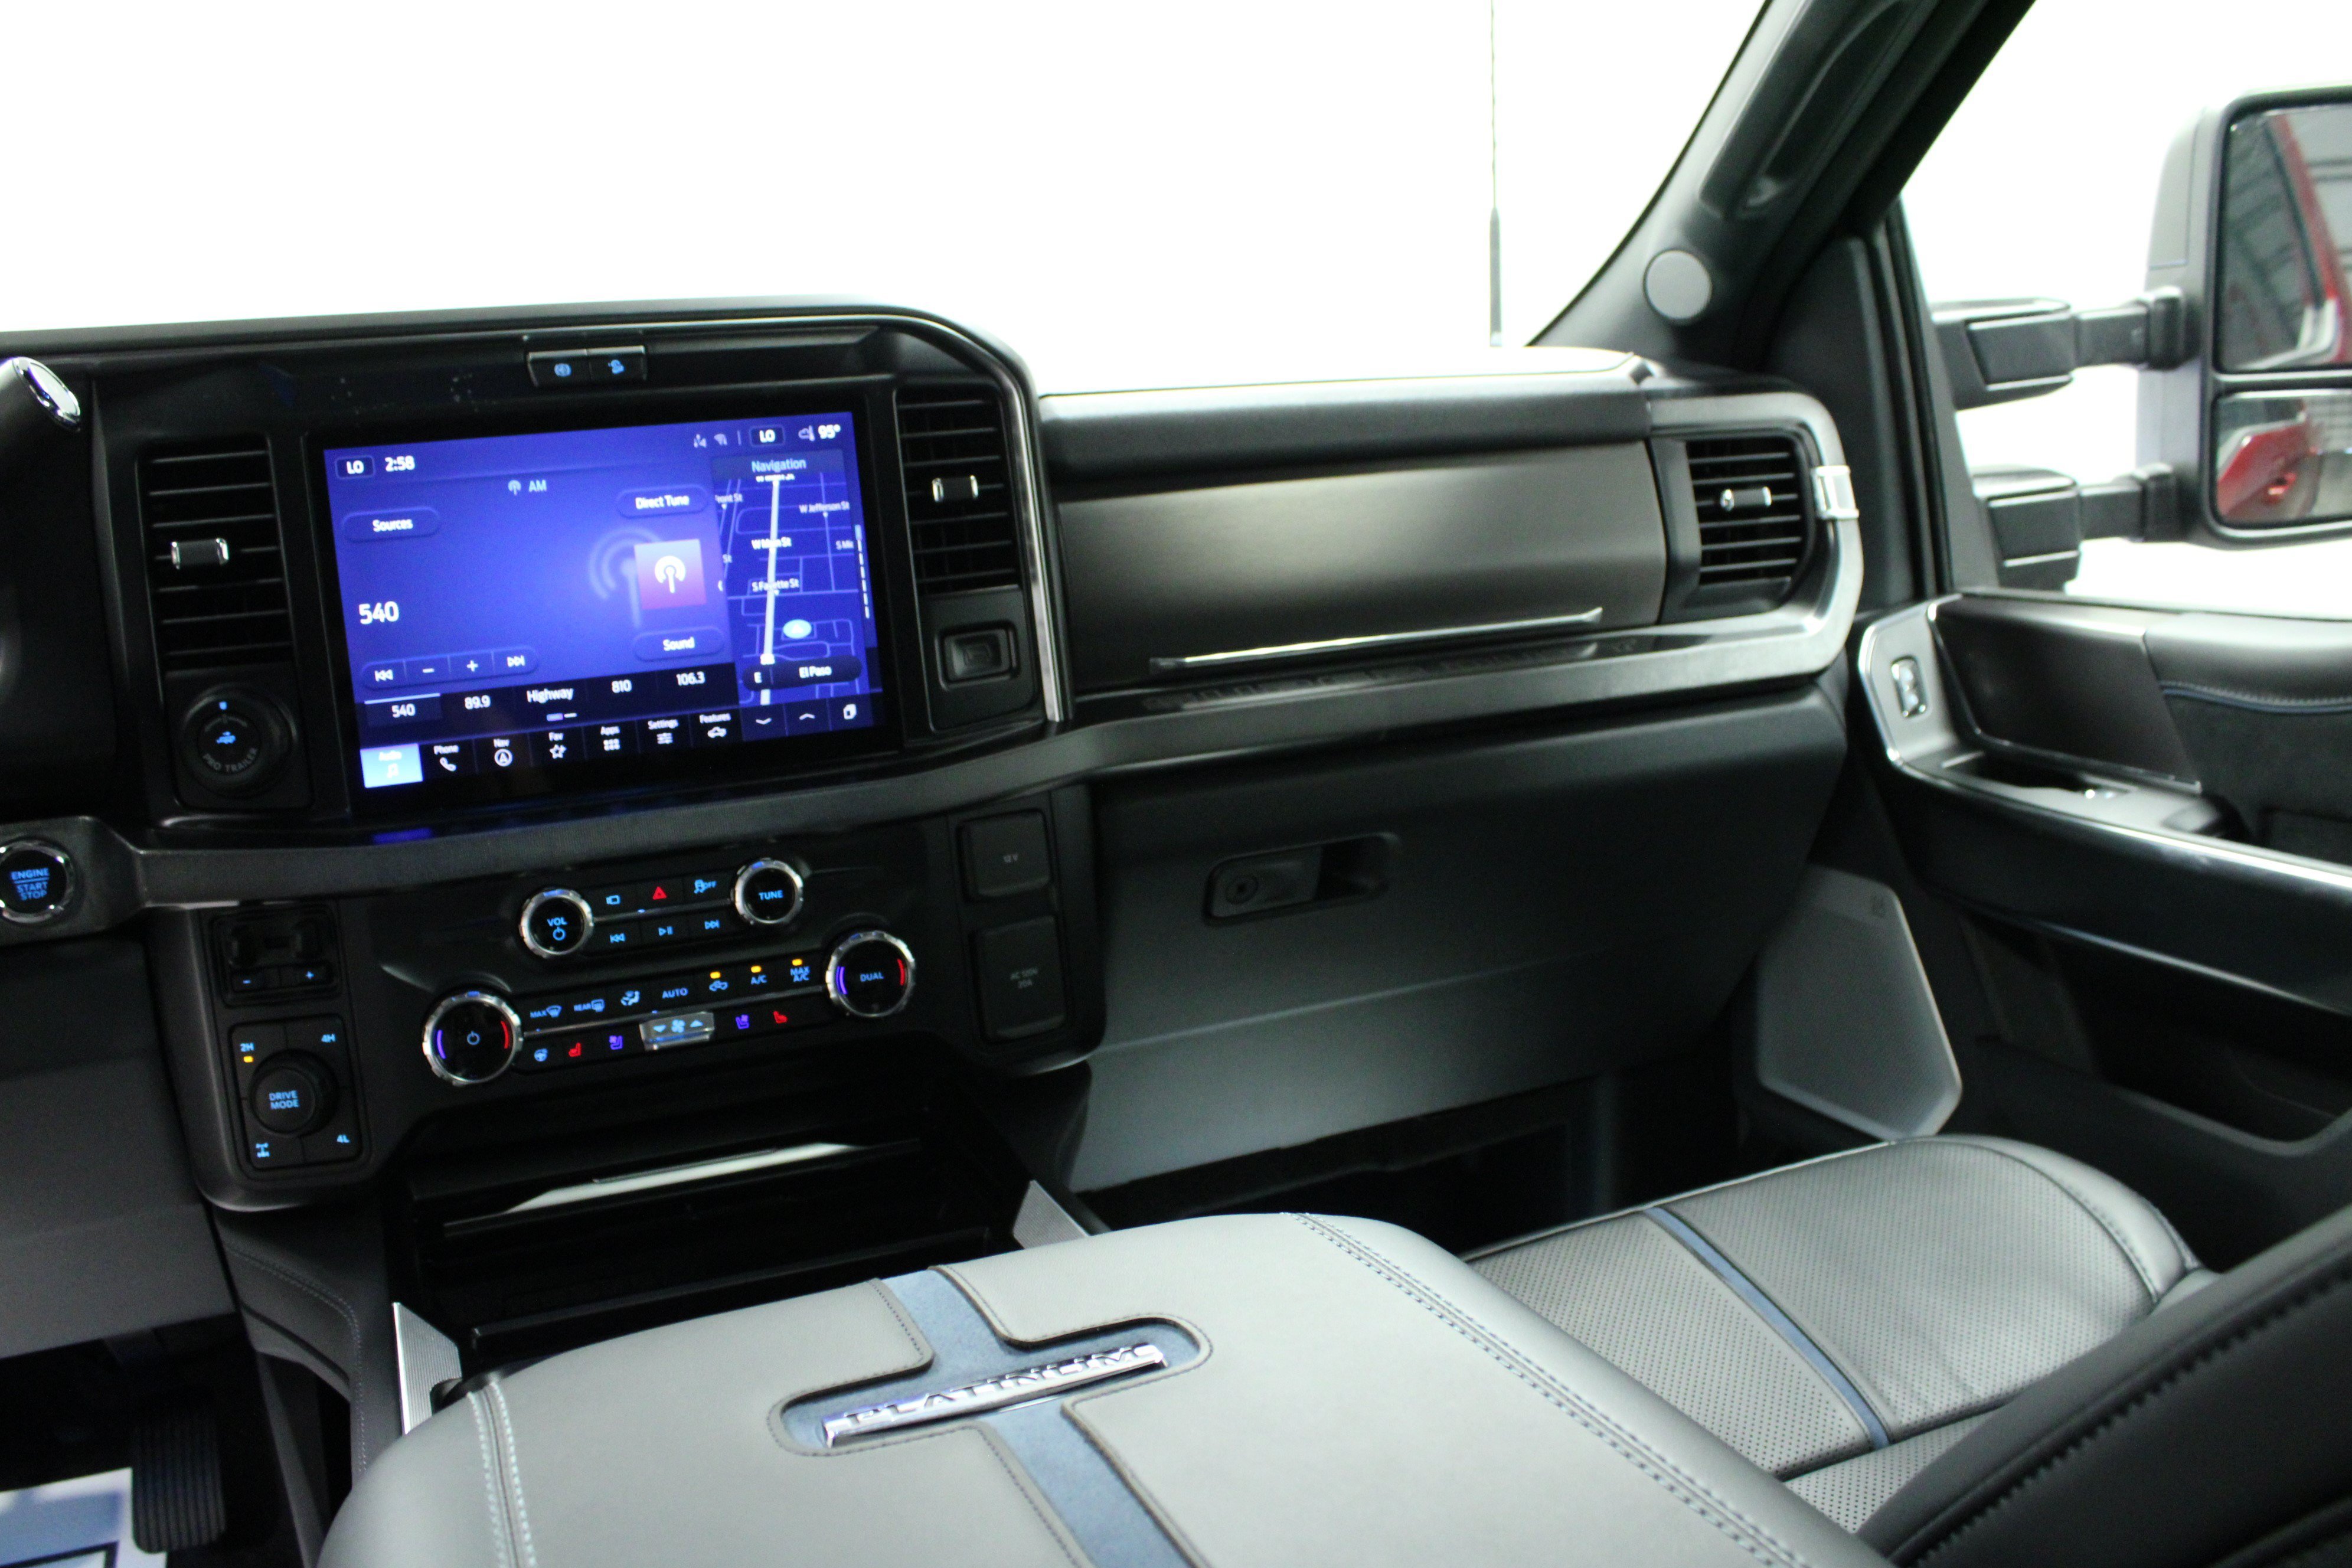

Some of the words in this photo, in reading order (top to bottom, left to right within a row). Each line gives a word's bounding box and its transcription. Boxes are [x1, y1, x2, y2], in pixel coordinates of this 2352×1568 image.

[759, 429, 775, 442] LO
[347, 460, 364, 474] LO
[385, 456, 414, 472] 2:58
[751, 458, 806, 472] Navigation
[529, 479, 547, 492] AM
[635, 496, 665, 509] Direct
[665, 495, 689, 507] Tune
[373, 519, 413, 532] Sources
[359, 601, 398, 624] 540
[663, 637, 695, 651] Sound
[677, 671, 705, 685] 106.3
[612, 680, 632, 692] 810
[527, 688, 573, 703] Highway
[465, 695, 490, 709] 89.9
[391, 704, 415, 717] 540
[648, 720, 678, 730] Settings
[494, 739, 509, 747] Nav
[433, 745, 458, 754] Phone
[11, 867, 49, 880] ENGINE
[17, 881, 47, 893] START
[21, 890, 47, 901] STOP
[759, 890, 783, 900] TUNE
[547, 917, 567, 926] VOL
[790, 966, 810, 975] MAX
[751, 975, 767, 984] A/C
[792, 974, 810, 982] A/C
[860, 972, 884, 982] DUAL
[662, 988, 688, 998] AUTO
[321, 1034, 335, 1043] 4H
[240, 1043, 254, 1052] 2H
[269, 1090, 298, 1101] DRIVE
[270, 1099, 299, 1110] MODE
[337, 1135, 349, 1143] 4L
[842, 1346, 1136, 1426] PLATINUM
